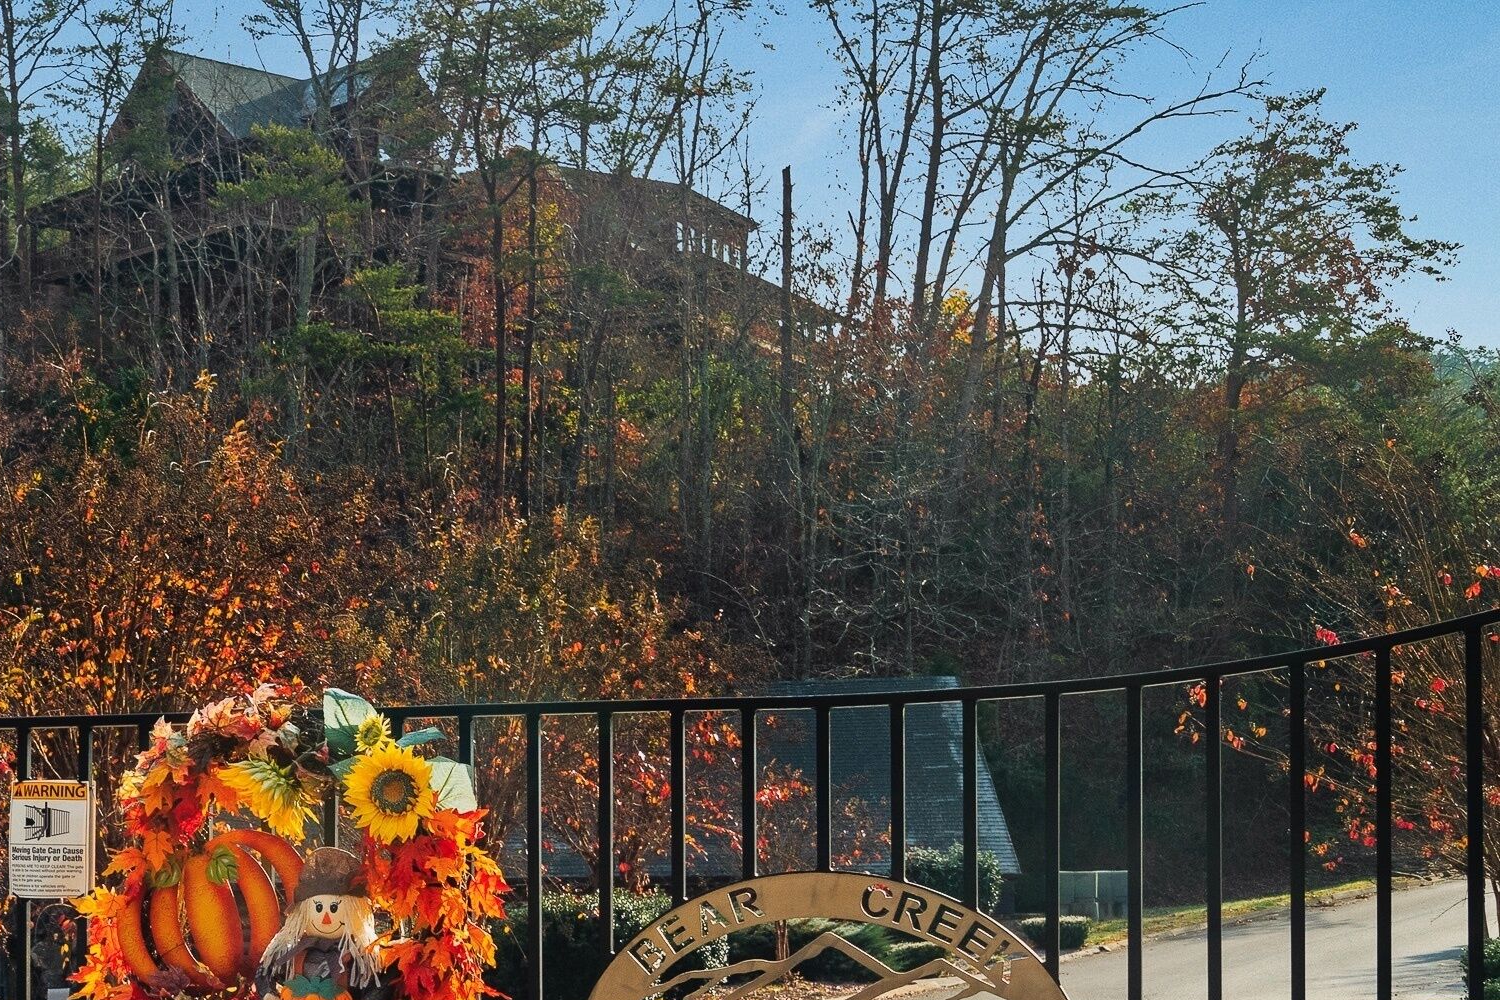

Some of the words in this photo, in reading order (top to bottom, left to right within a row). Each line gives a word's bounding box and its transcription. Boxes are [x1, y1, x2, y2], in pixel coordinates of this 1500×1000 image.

[24, 784, 85, 797] WARNING
[12, 847, 30, 855] Moving
[33, 854, 51, 862] Injury
[627, 886, 765, 976] BEAR
[860, 883, 1028, 984] CREEK
